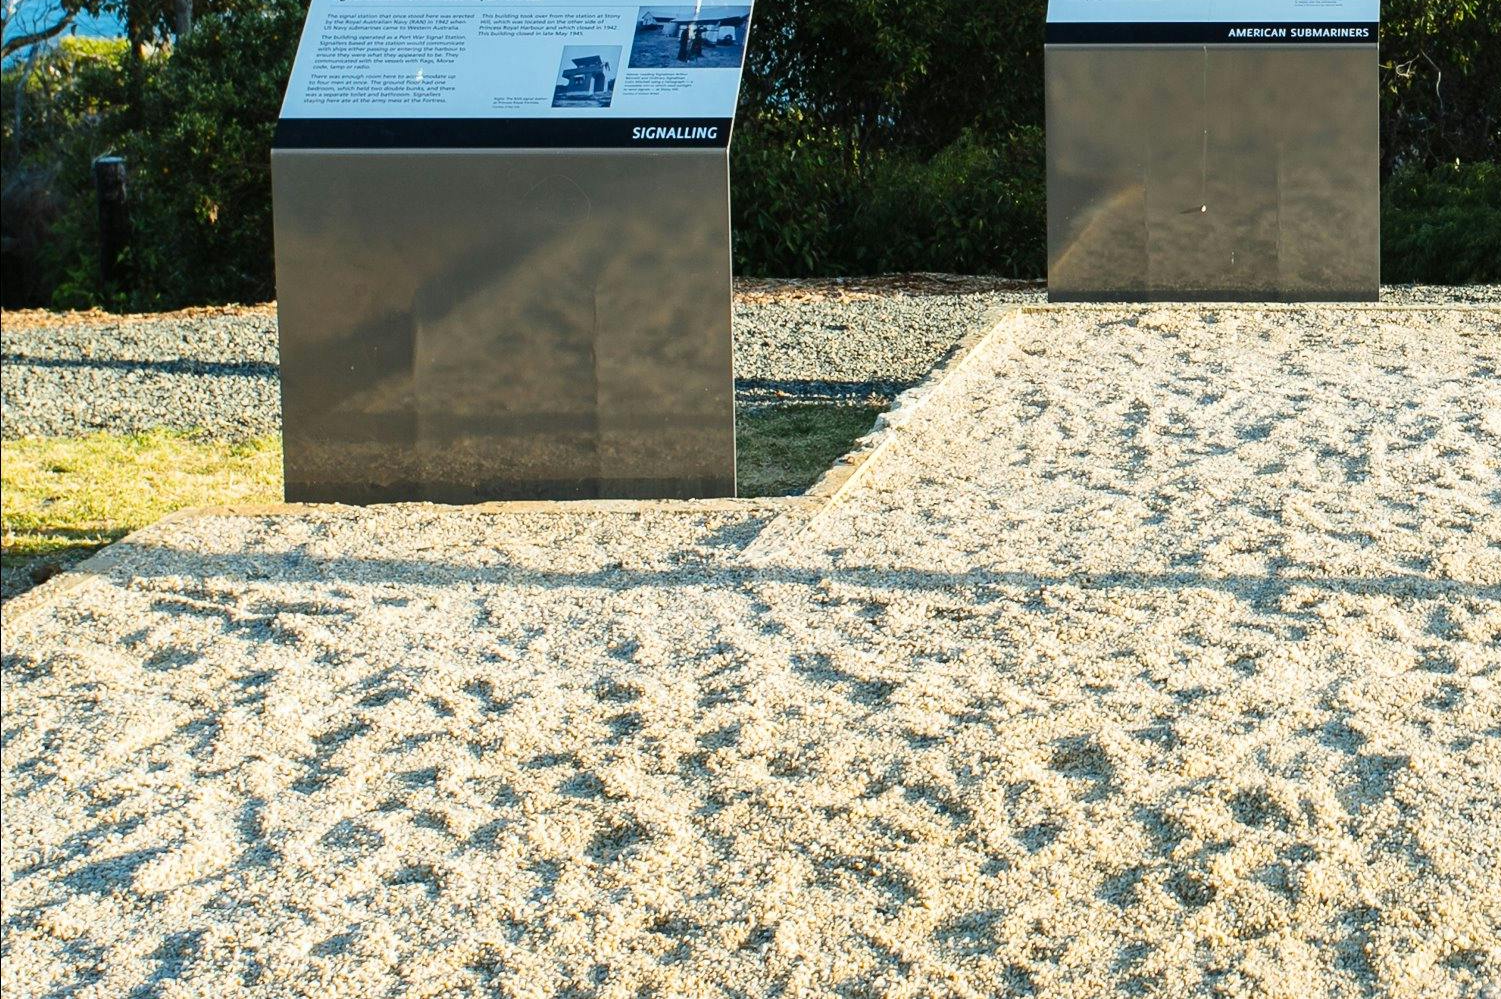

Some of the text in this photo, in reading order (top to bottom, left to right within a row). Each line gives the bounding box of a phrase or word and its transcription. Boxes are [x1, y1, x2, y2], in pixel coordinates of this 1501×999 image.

[1228, 28, 1369, 37] AMERICAN SUBMARINERS
[633, 127, 717, 139] SIGNALLING
